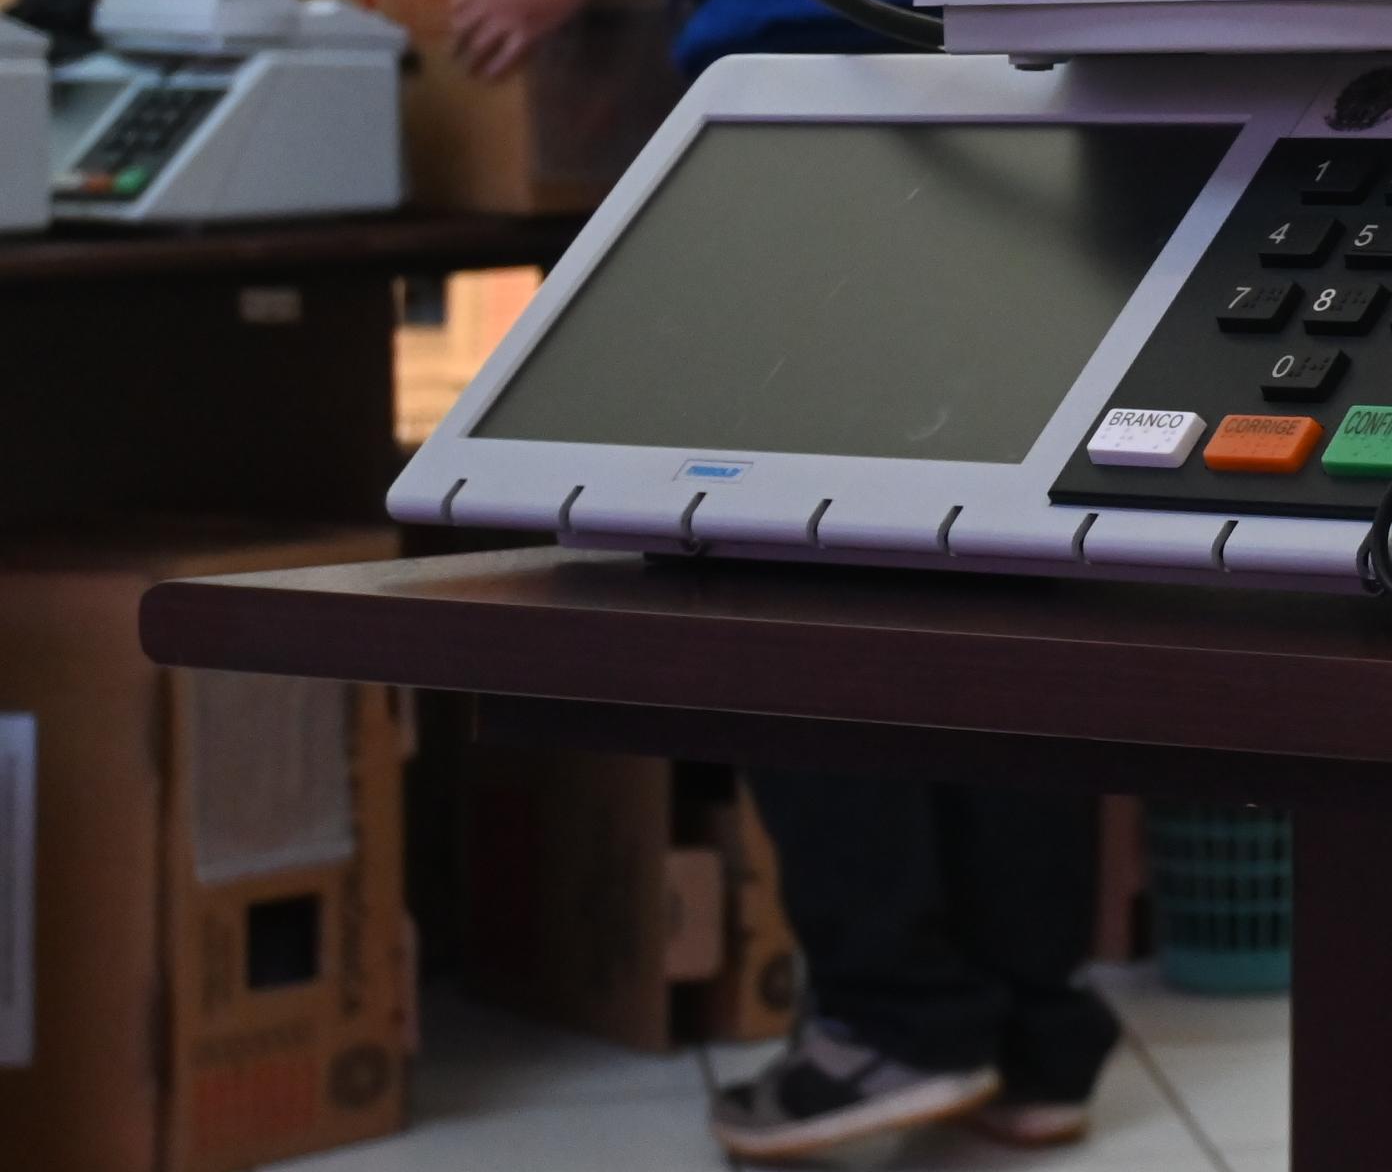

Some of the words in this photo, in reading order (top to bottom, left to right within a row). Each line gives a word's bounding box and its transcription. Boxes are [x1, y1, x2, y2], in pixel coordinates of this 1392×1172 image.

[1314, 160, 1331, 182] 1
[1268, 222, 1290, 244] 4
[1354, 224, 1379, 247] 5
[1227, 286, 1252, 309] 7
[1312, 288, 1337, 312] 8
[1271, 354, 1295, 378] 0
[1108, 411, 1184, 429] BRANCO
[1224, 418, 1301, 436] CORRIGE
